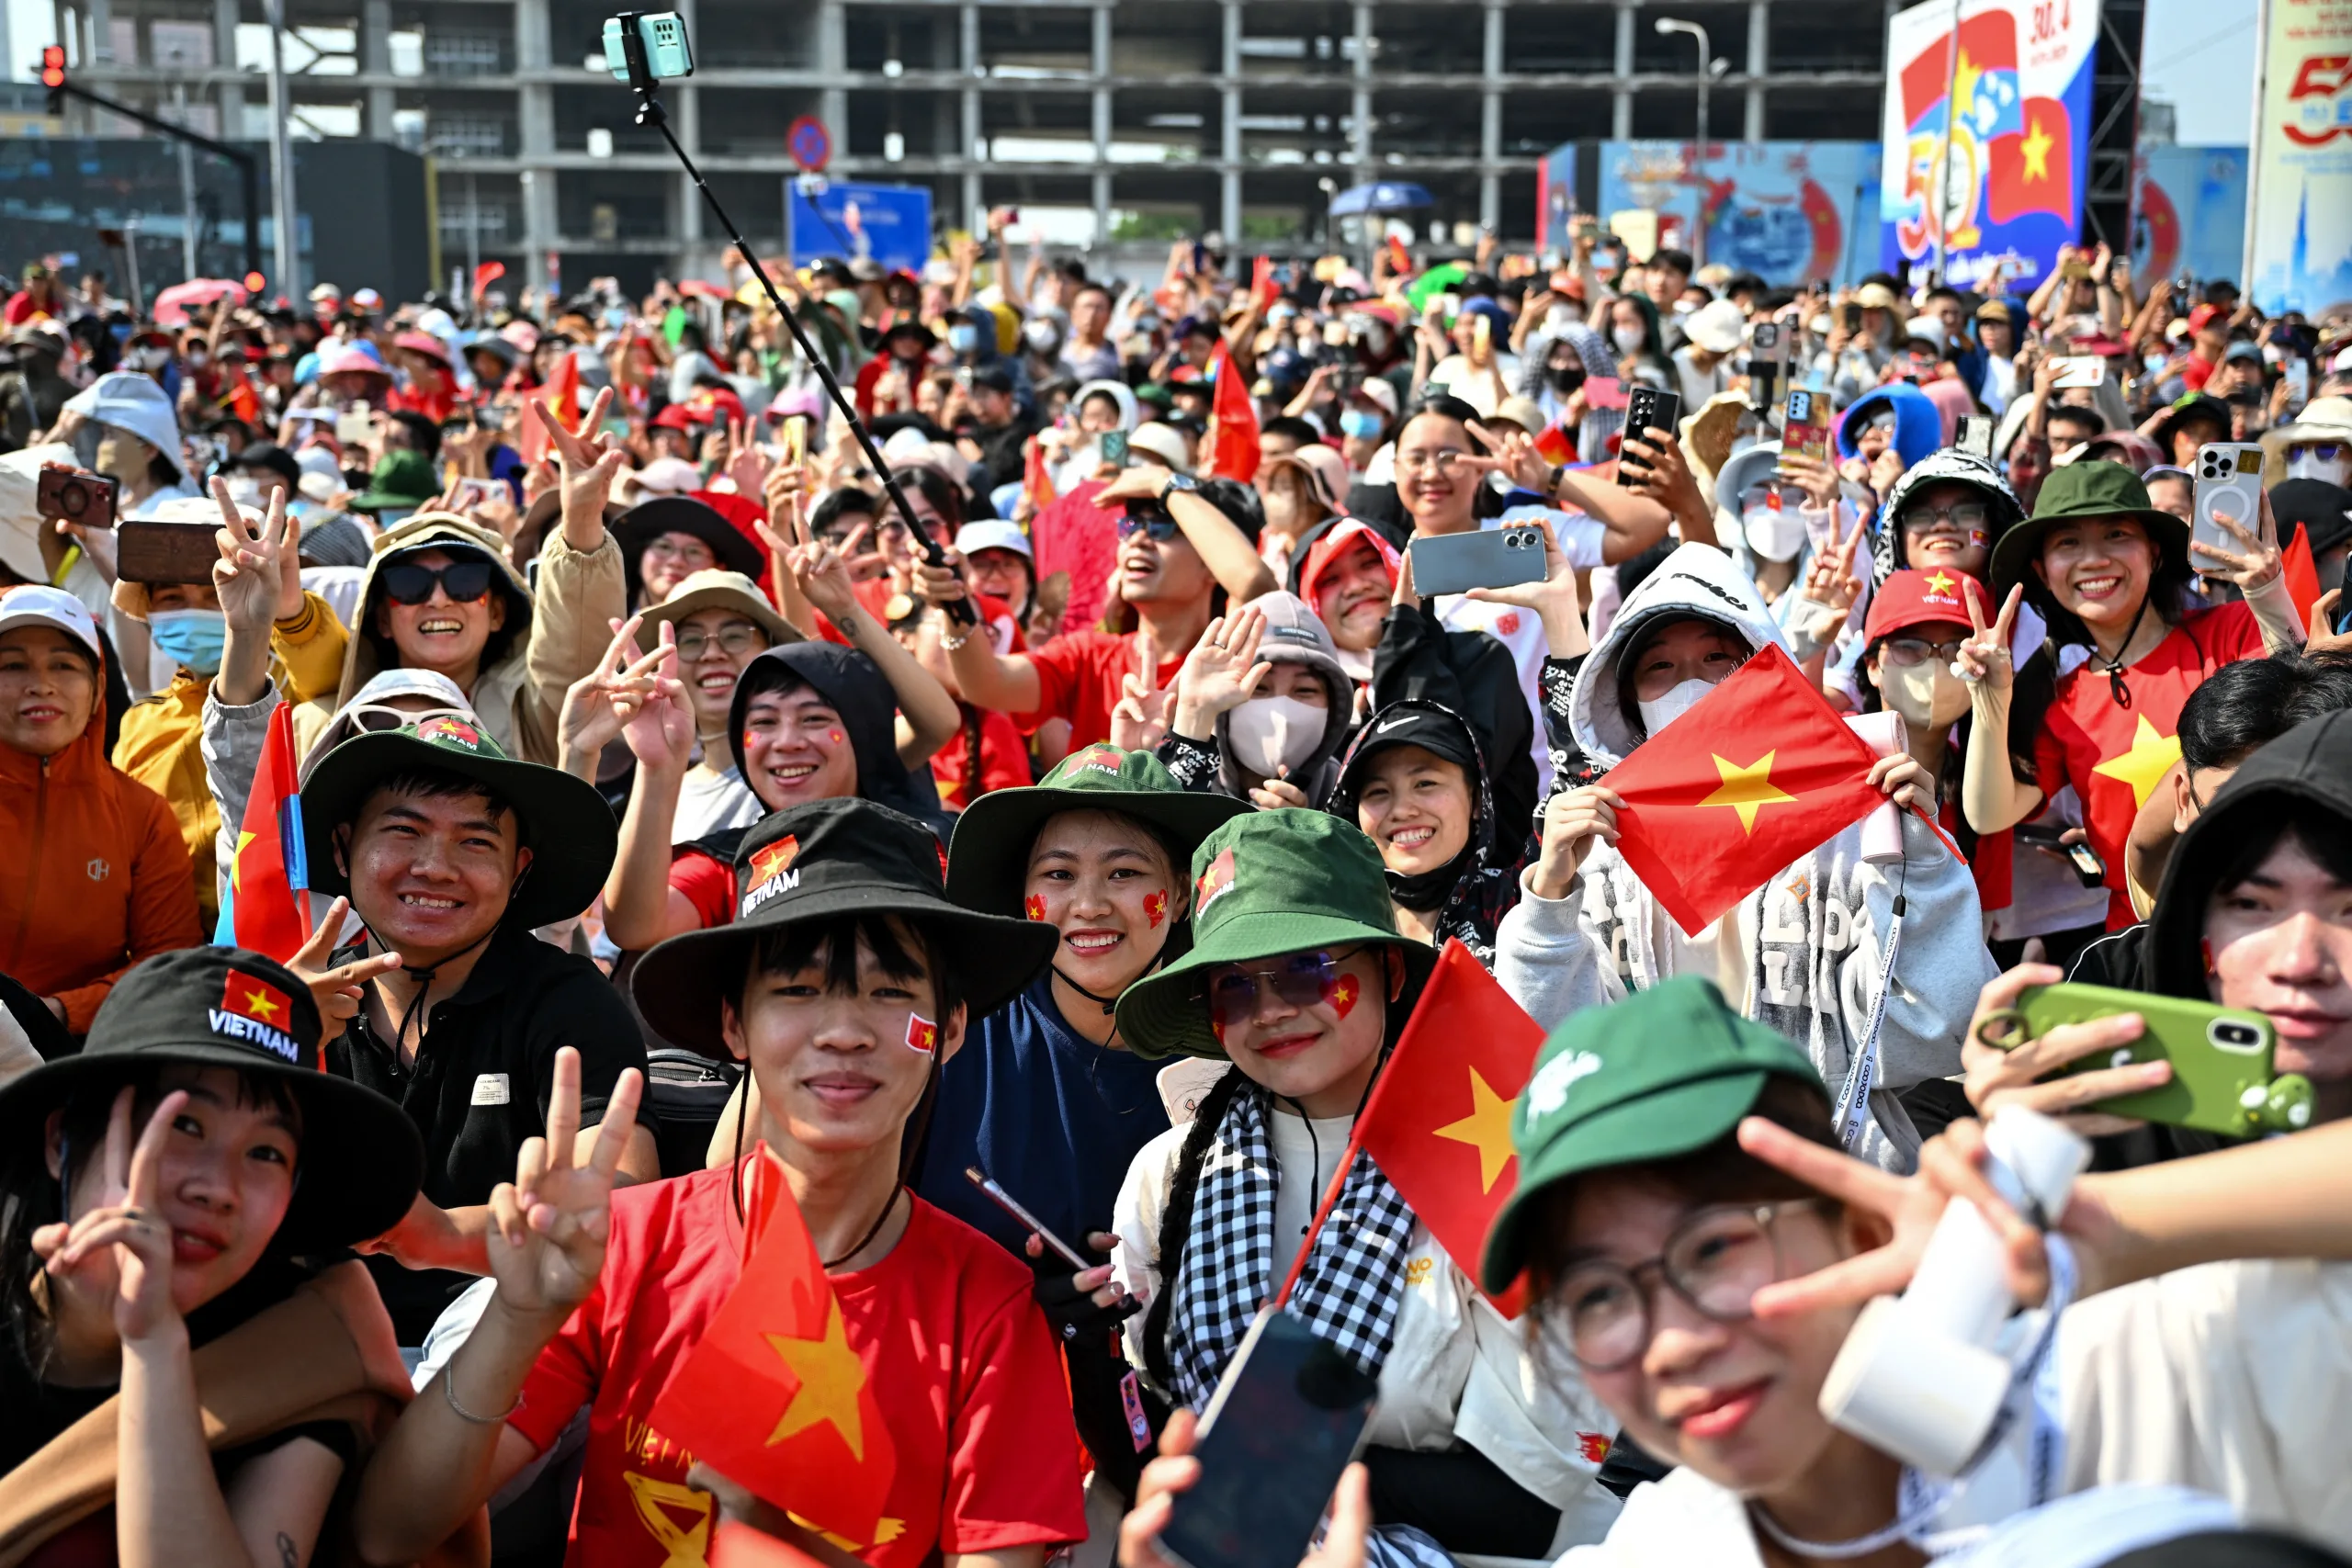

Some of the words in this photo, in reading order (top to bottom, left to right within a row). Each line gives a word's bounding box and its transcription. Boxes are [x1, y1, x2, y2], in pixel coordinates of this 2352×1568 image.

[447, 734, 478, 750] NAM
[1087, 763, 1118, 776] NAM
[209, 1008, 299, 1063] VIETNAM
